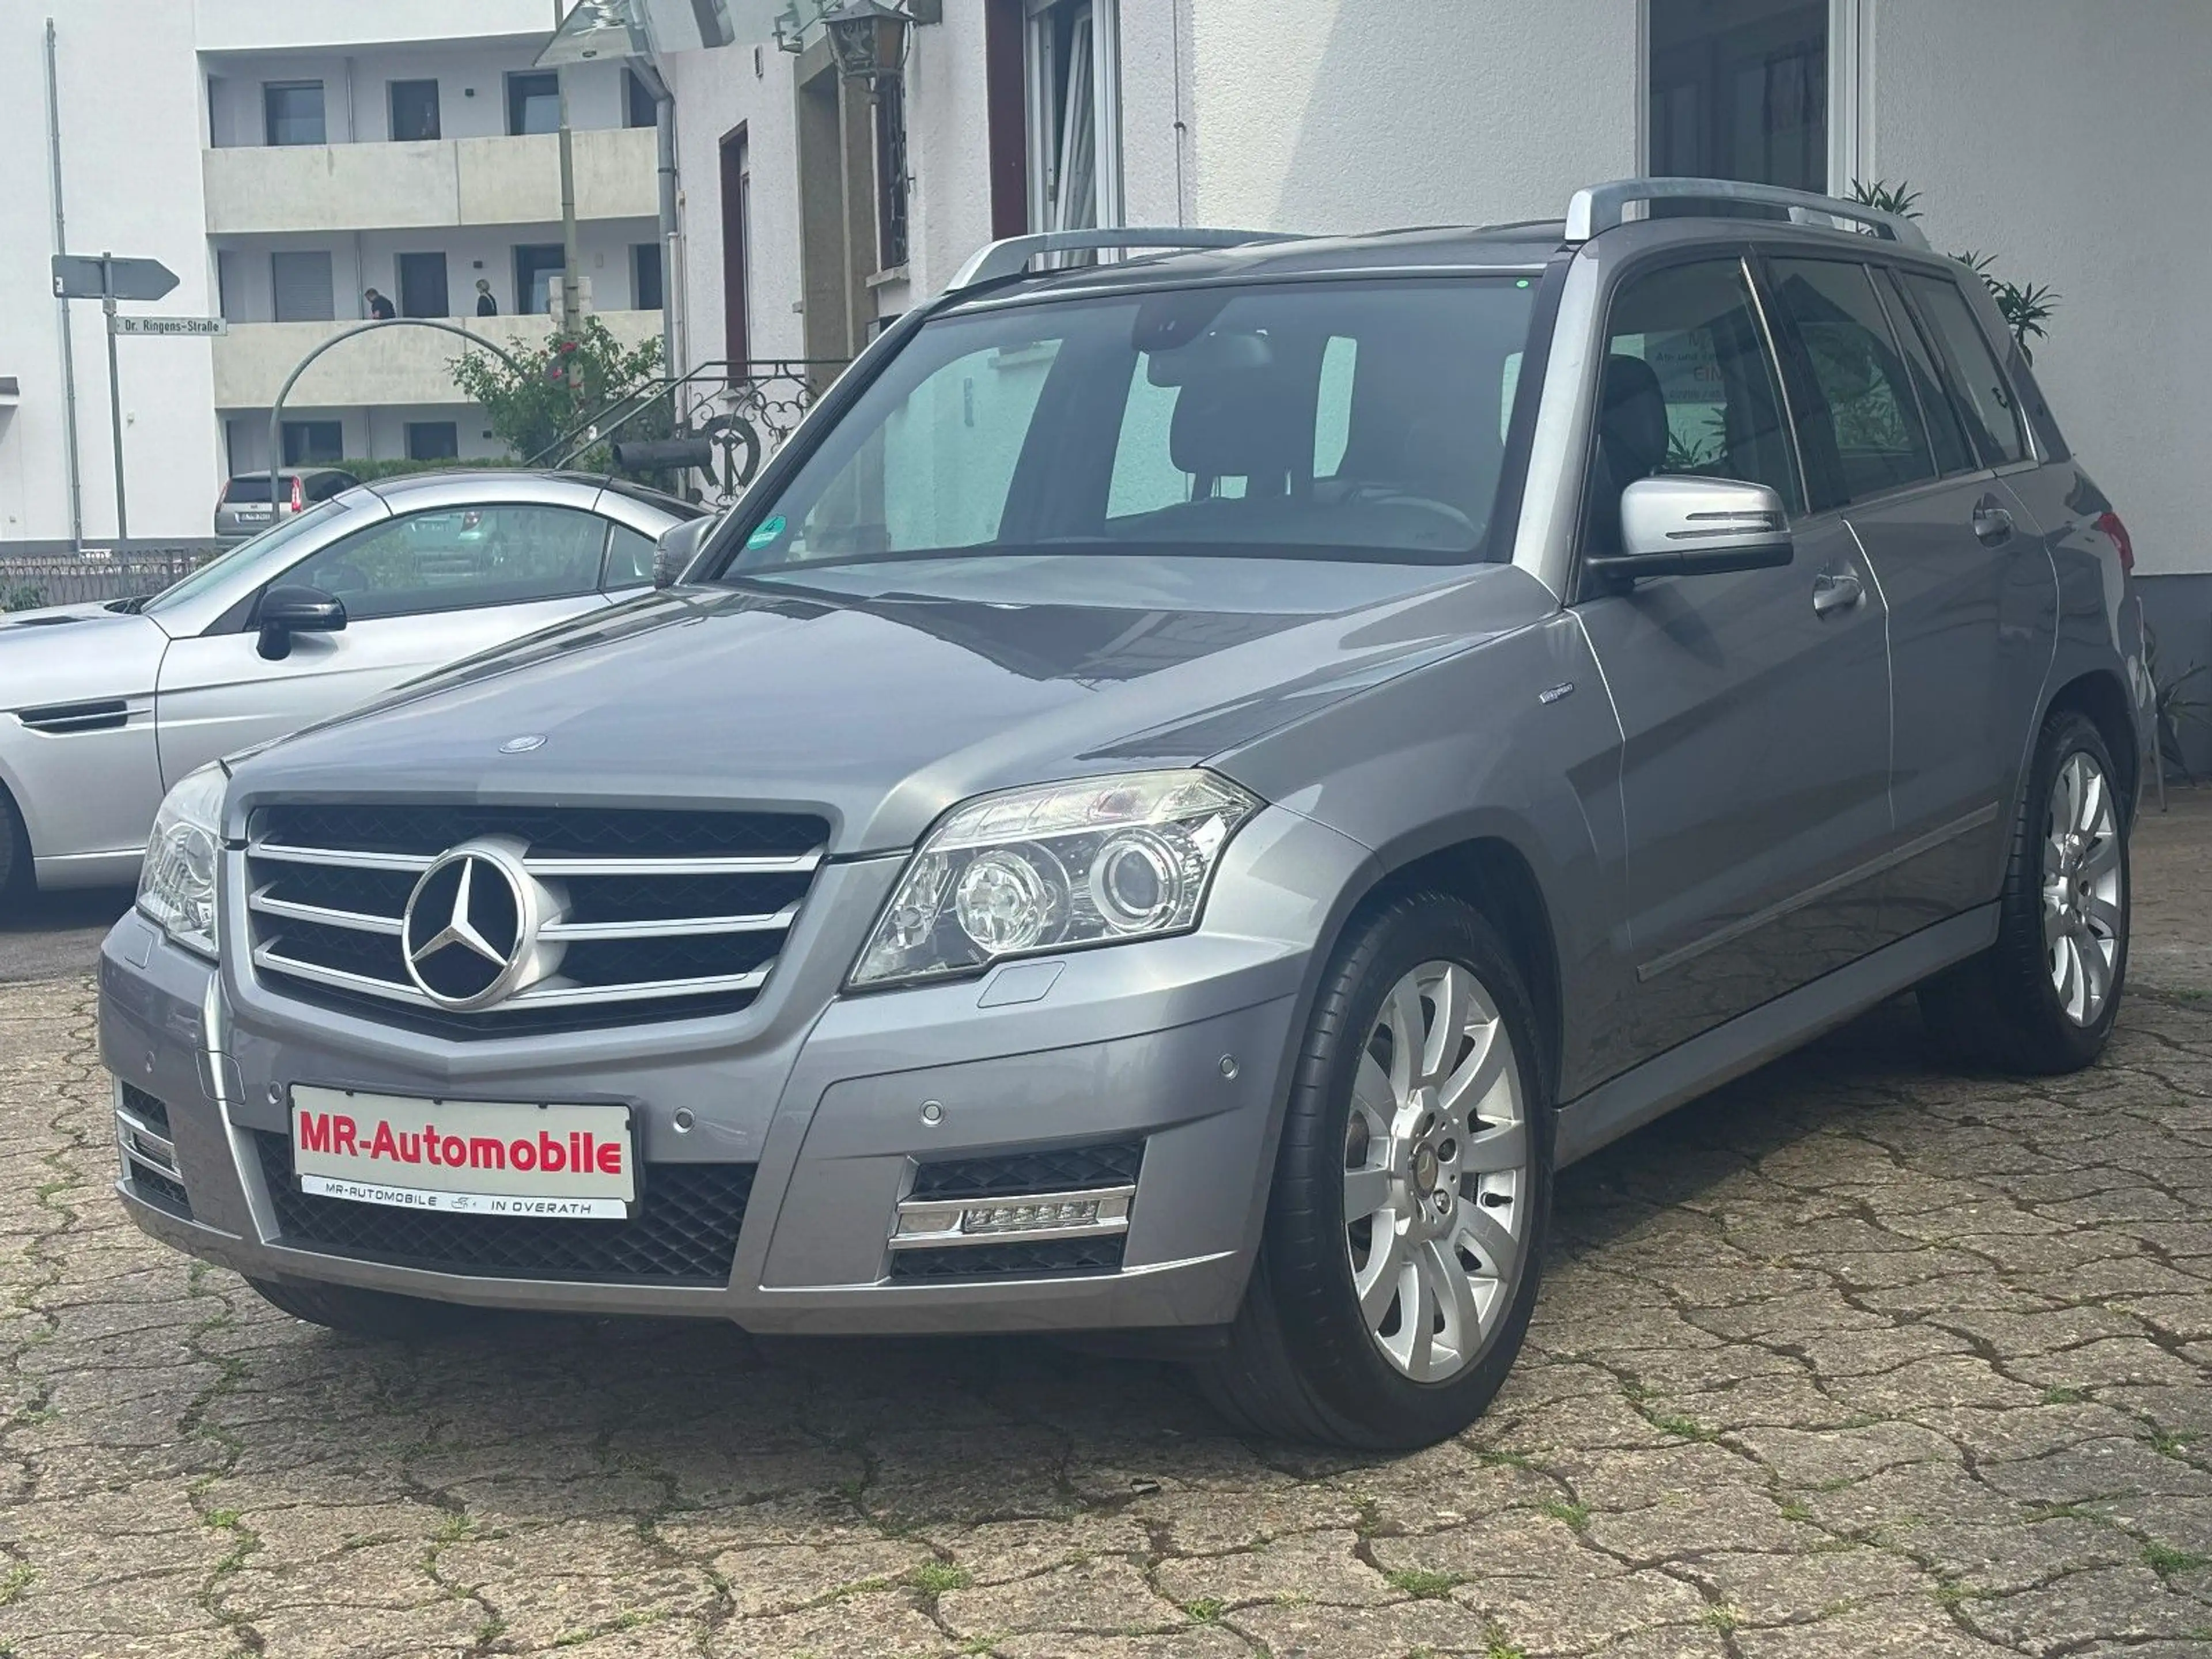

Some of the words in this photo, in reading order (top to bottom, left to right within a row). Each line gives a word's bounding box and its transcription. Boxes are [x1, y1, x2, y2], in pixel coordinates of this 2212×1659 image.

[125, 319, 138, 331] Dr.
[143, 319, 219, 334] Ringens-Straße
[300, 1110, 621, 1175] MR-Automobile
[325, 1183, 438, 1207] MR-AUTOMOBILE
[491, 1200, 506, 1211] IN
[513, 1202, 592, 1214] OVERATH
